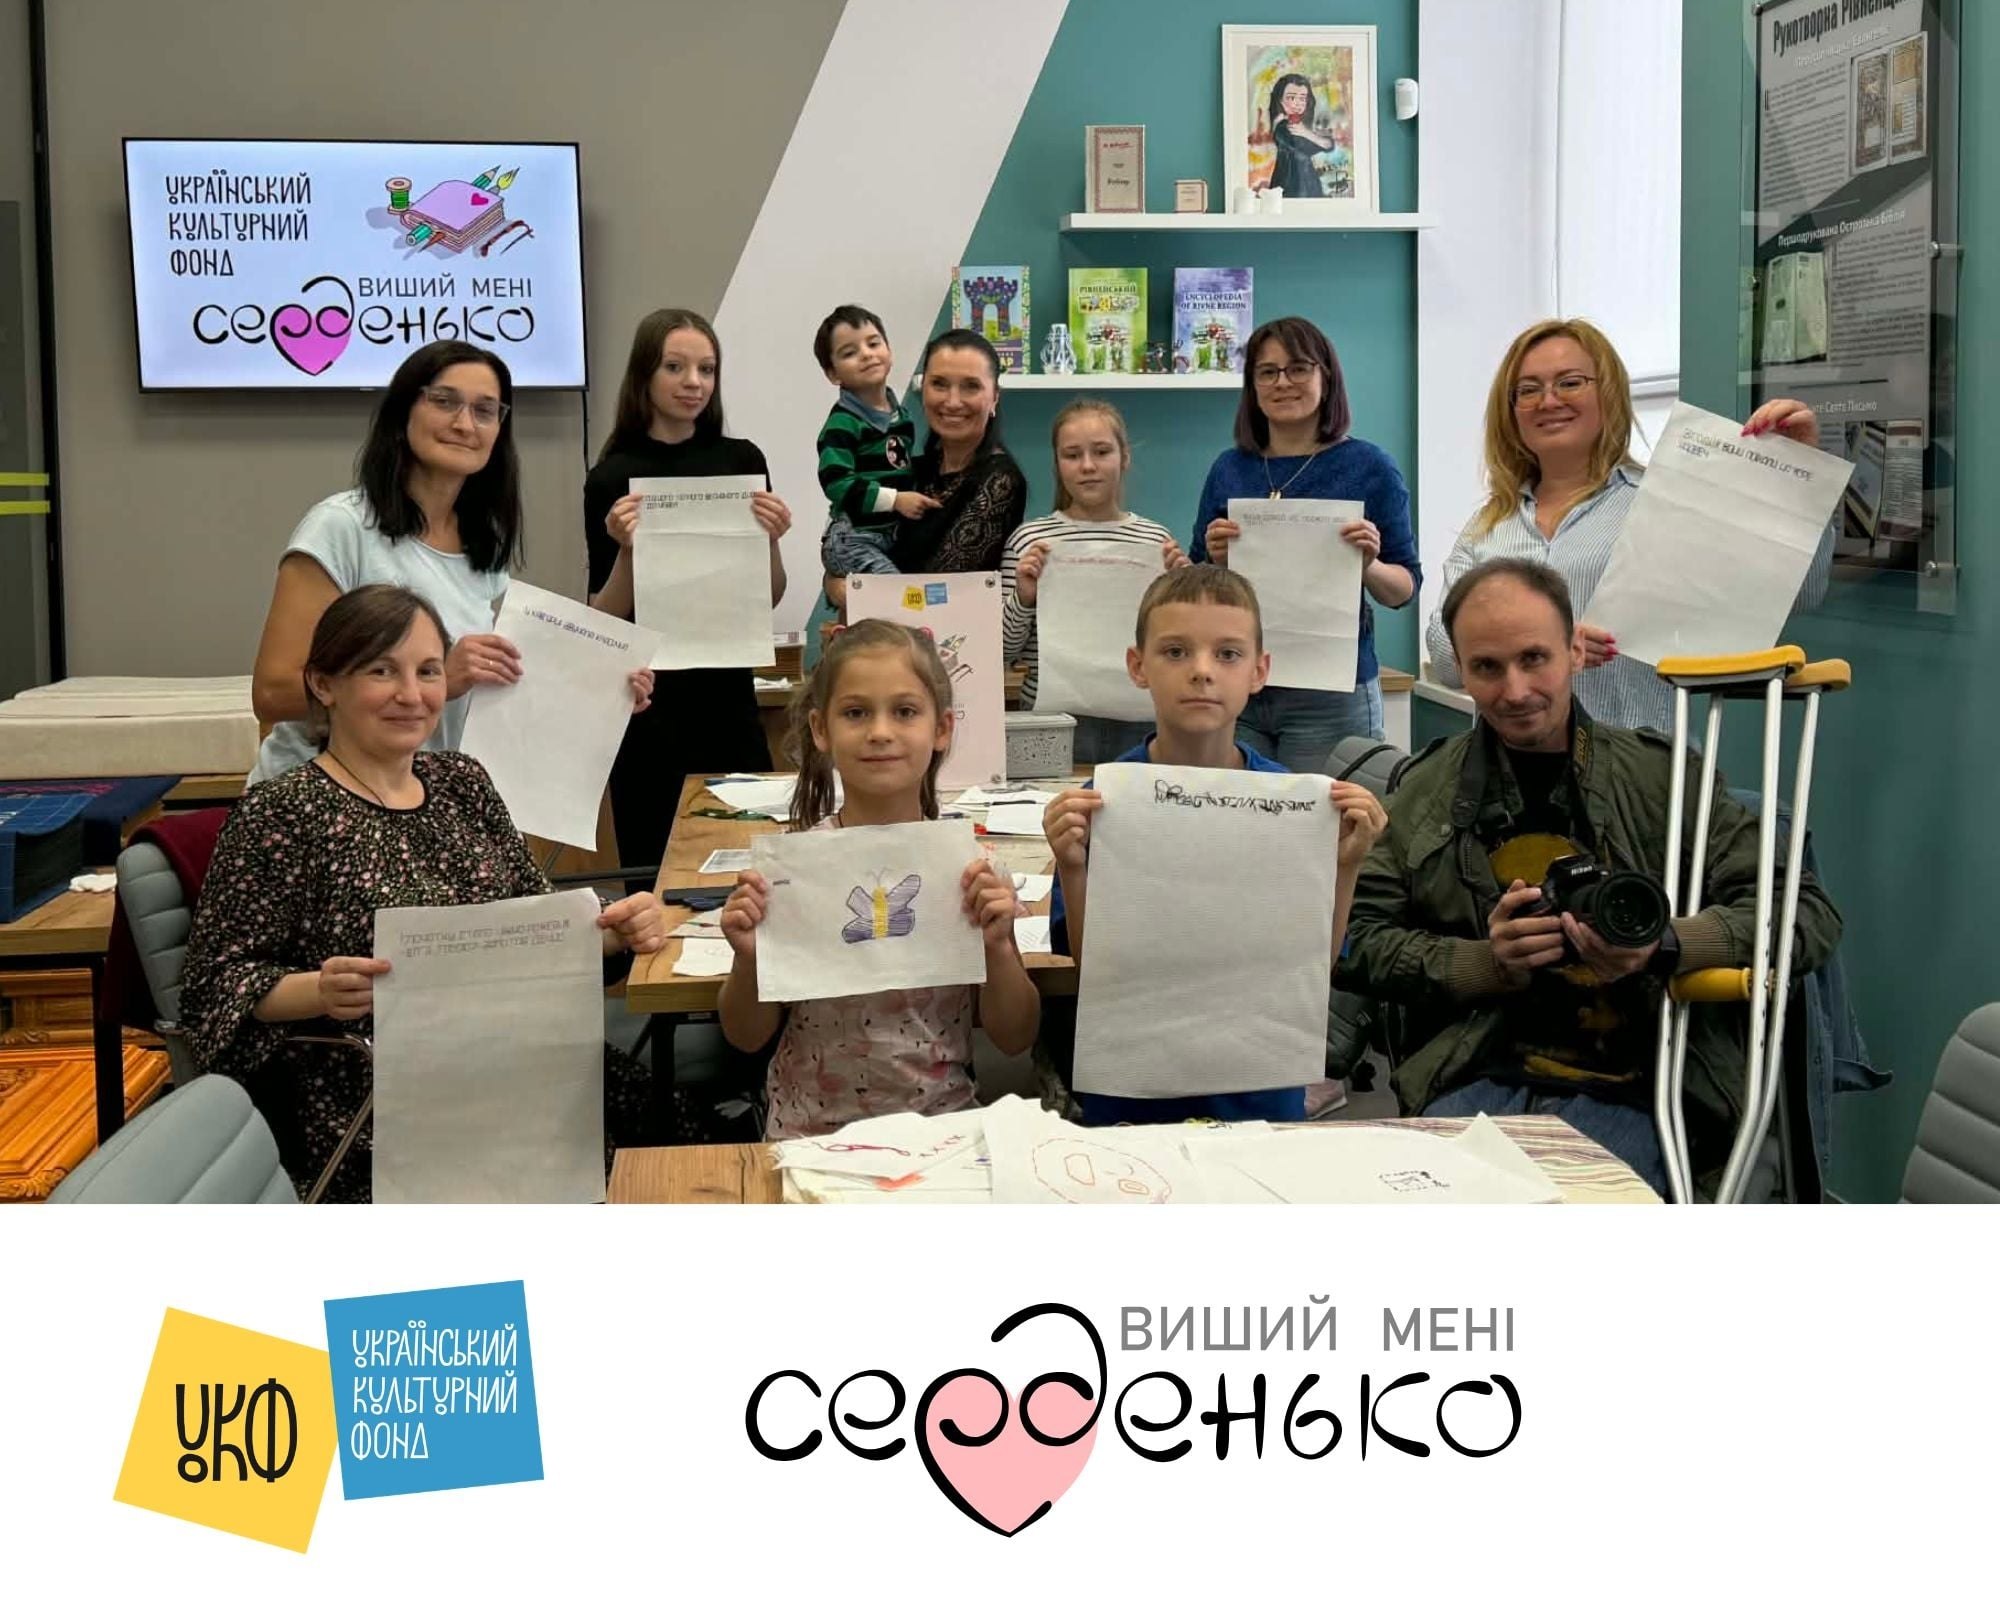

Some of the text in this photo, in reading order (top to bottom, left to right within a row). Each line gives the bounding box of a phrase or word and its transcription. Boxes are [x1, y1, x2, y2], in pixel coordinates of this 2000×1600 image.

[1774, 2, 1838, 58] Рукотворна
[165, 169, 311, 205] УКРАЇНСЬКИЙ
[168, 208, 308, 241] КУЛЬТУРНИЙ
[170, 248, 234, 276] ФОНД
[358, 272, 532, 298] ВИШИЙ МЕНІ
[1185, 293, 1242, 301] ENCYCLOPEDIA
